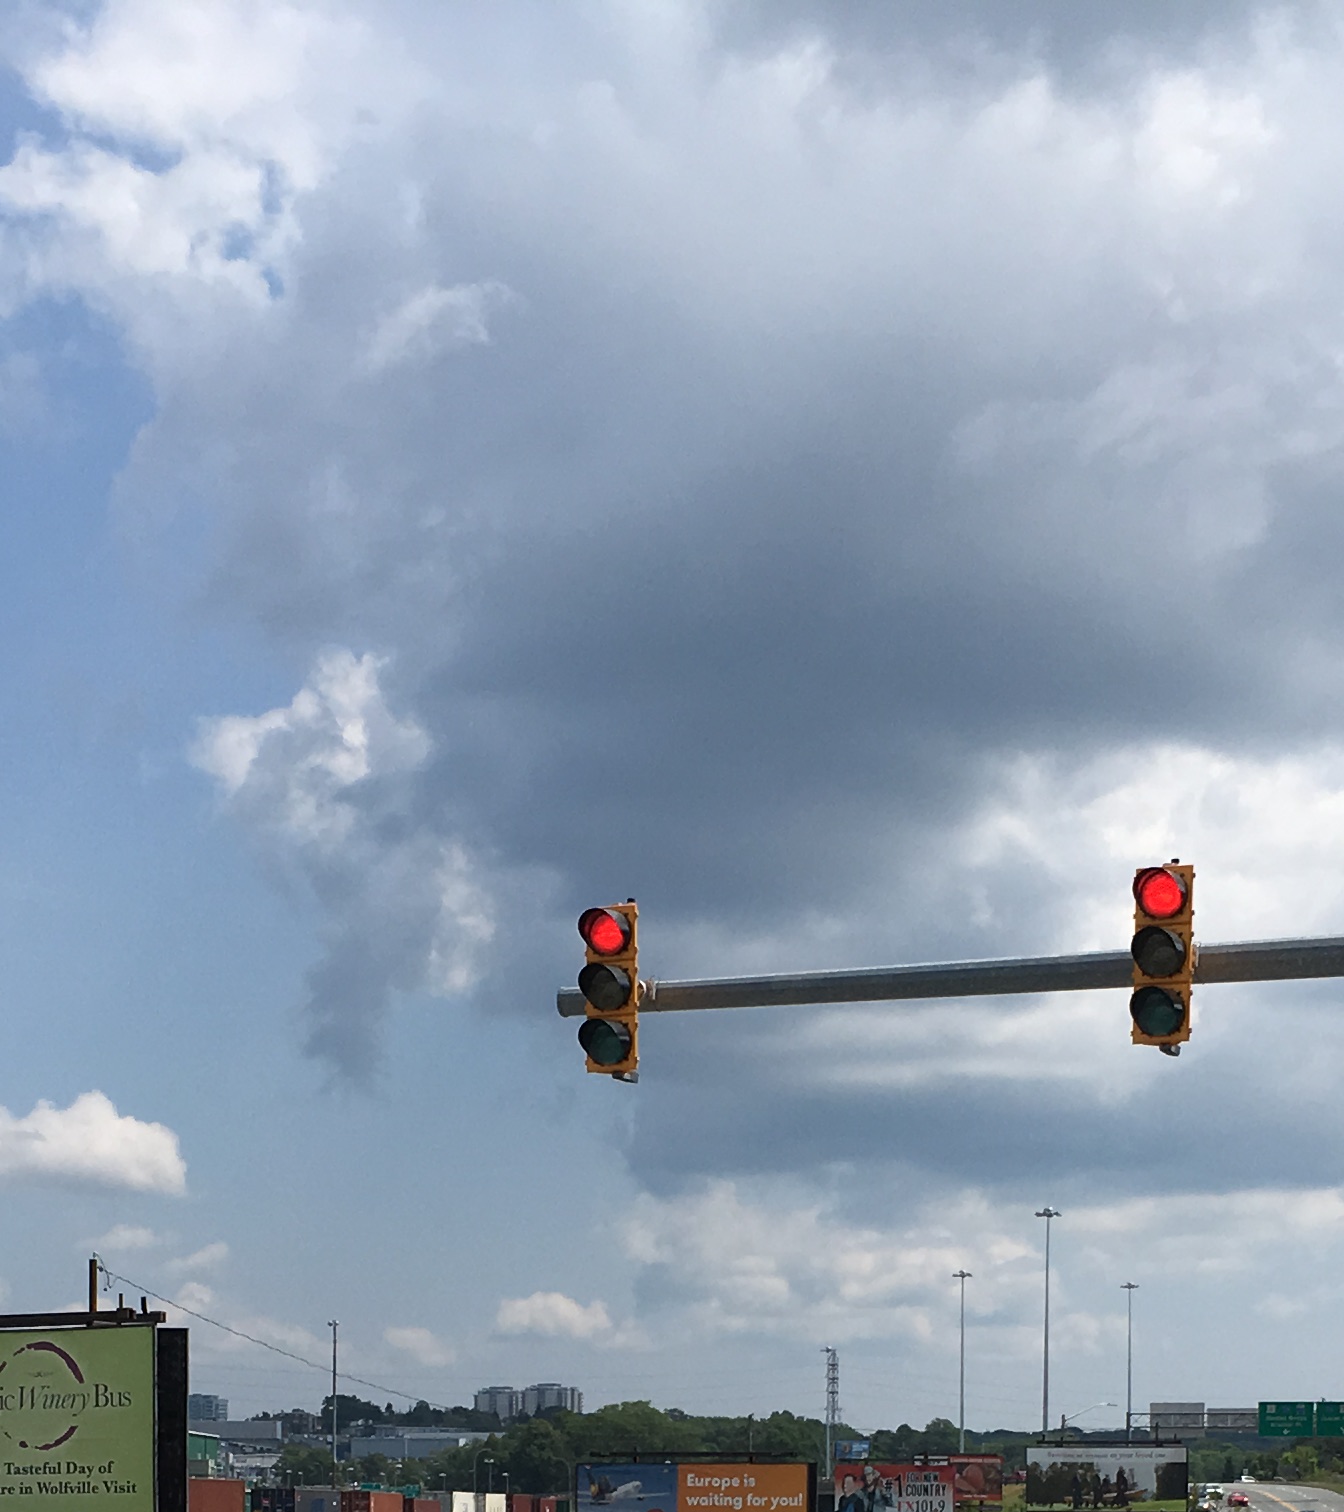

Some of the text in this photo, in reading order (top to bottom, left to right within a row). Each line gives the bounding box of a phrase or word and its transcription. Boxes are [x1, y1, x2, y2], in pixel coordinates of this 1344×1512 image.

[18, 1385, 90, 1417] Winery
[93, 1383, 132, 1408] Bus
[4, 1461, 61, 1475] Tasteful
[66, 1461, 94, 1478] Day
[98, 1460, 115, 1474] of
[19, 1482, 34, 1494] in
[37, 1481, 99, 1495] Wolfville
[102, 1480, 138, 1494] Visit
[686, 1473, 756, 1489] Europe is
[905, 1483, 947, 1497] COUNTRY
[685, 1493, 804, 1510] waiting for you!
